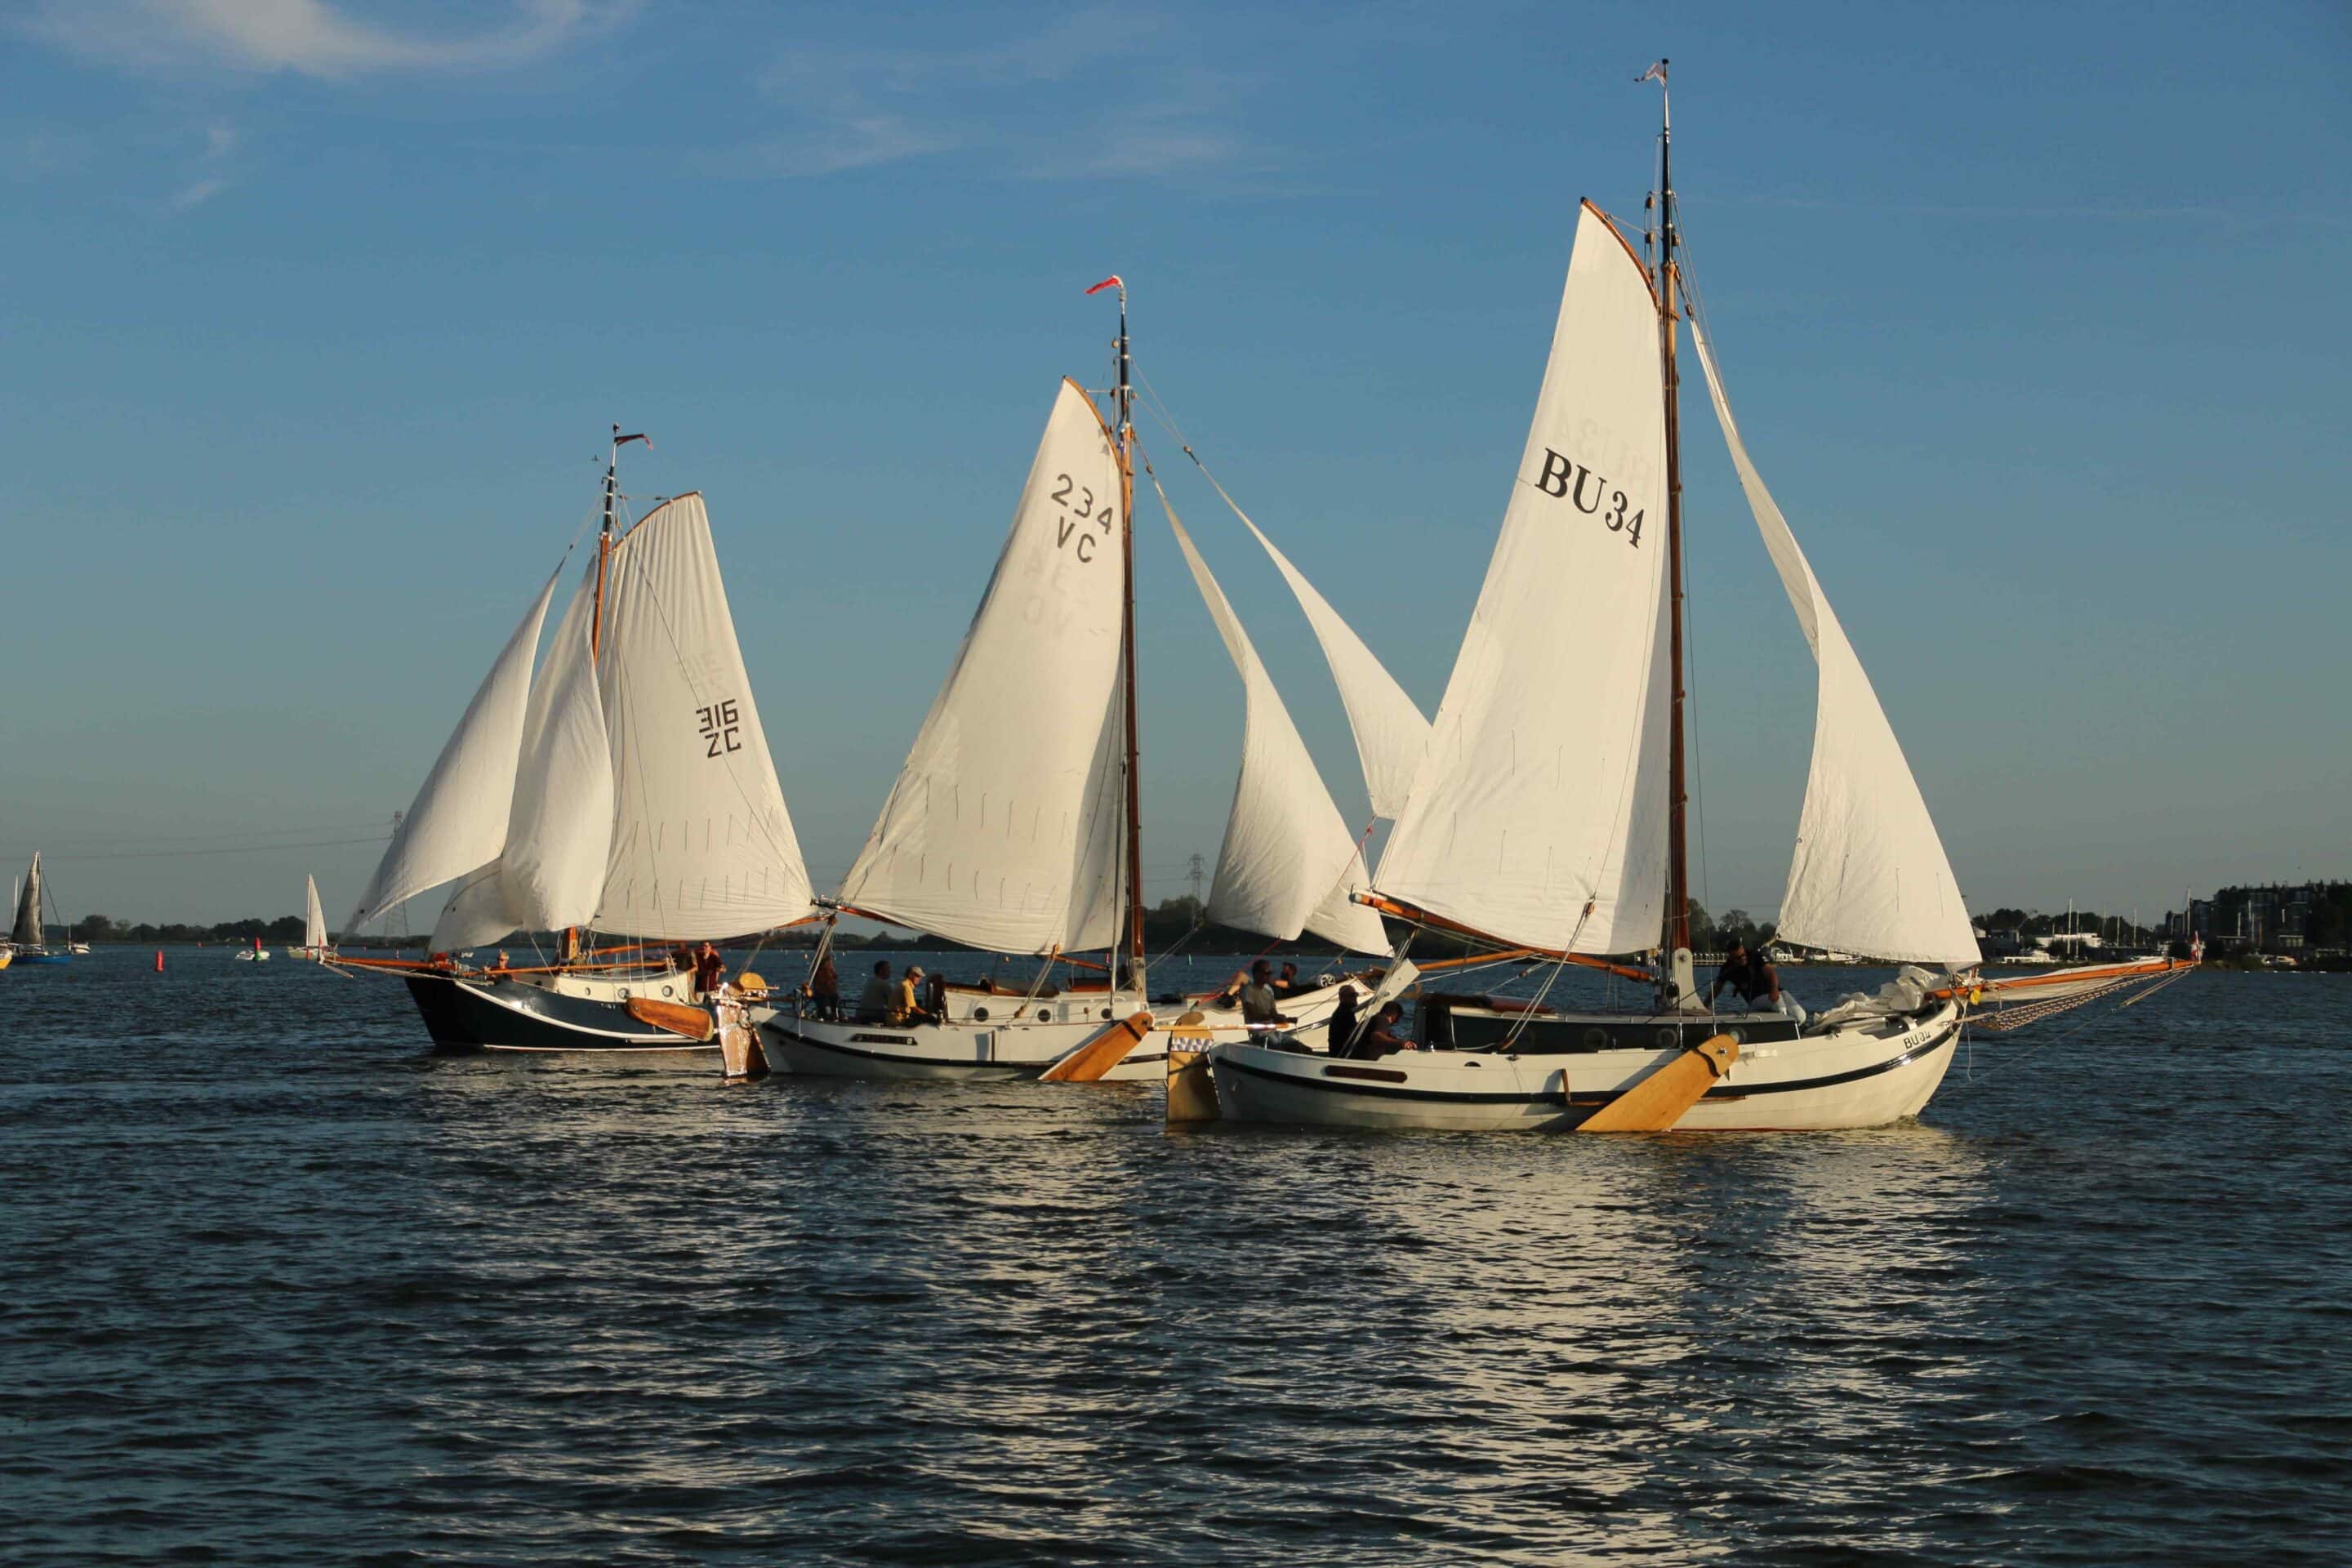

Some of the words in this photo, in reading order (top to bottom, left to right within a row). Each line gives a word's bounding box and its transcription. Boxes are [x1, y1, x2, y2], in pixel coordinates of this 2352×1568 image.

[1050, 473, 1114, 536] 234
[1535, 447, 1645, 550] BU34
[1057, 515, 1097, 564] VC
[695, 698, 739, 733] 316
[704, 725, 742, 759] ZC
